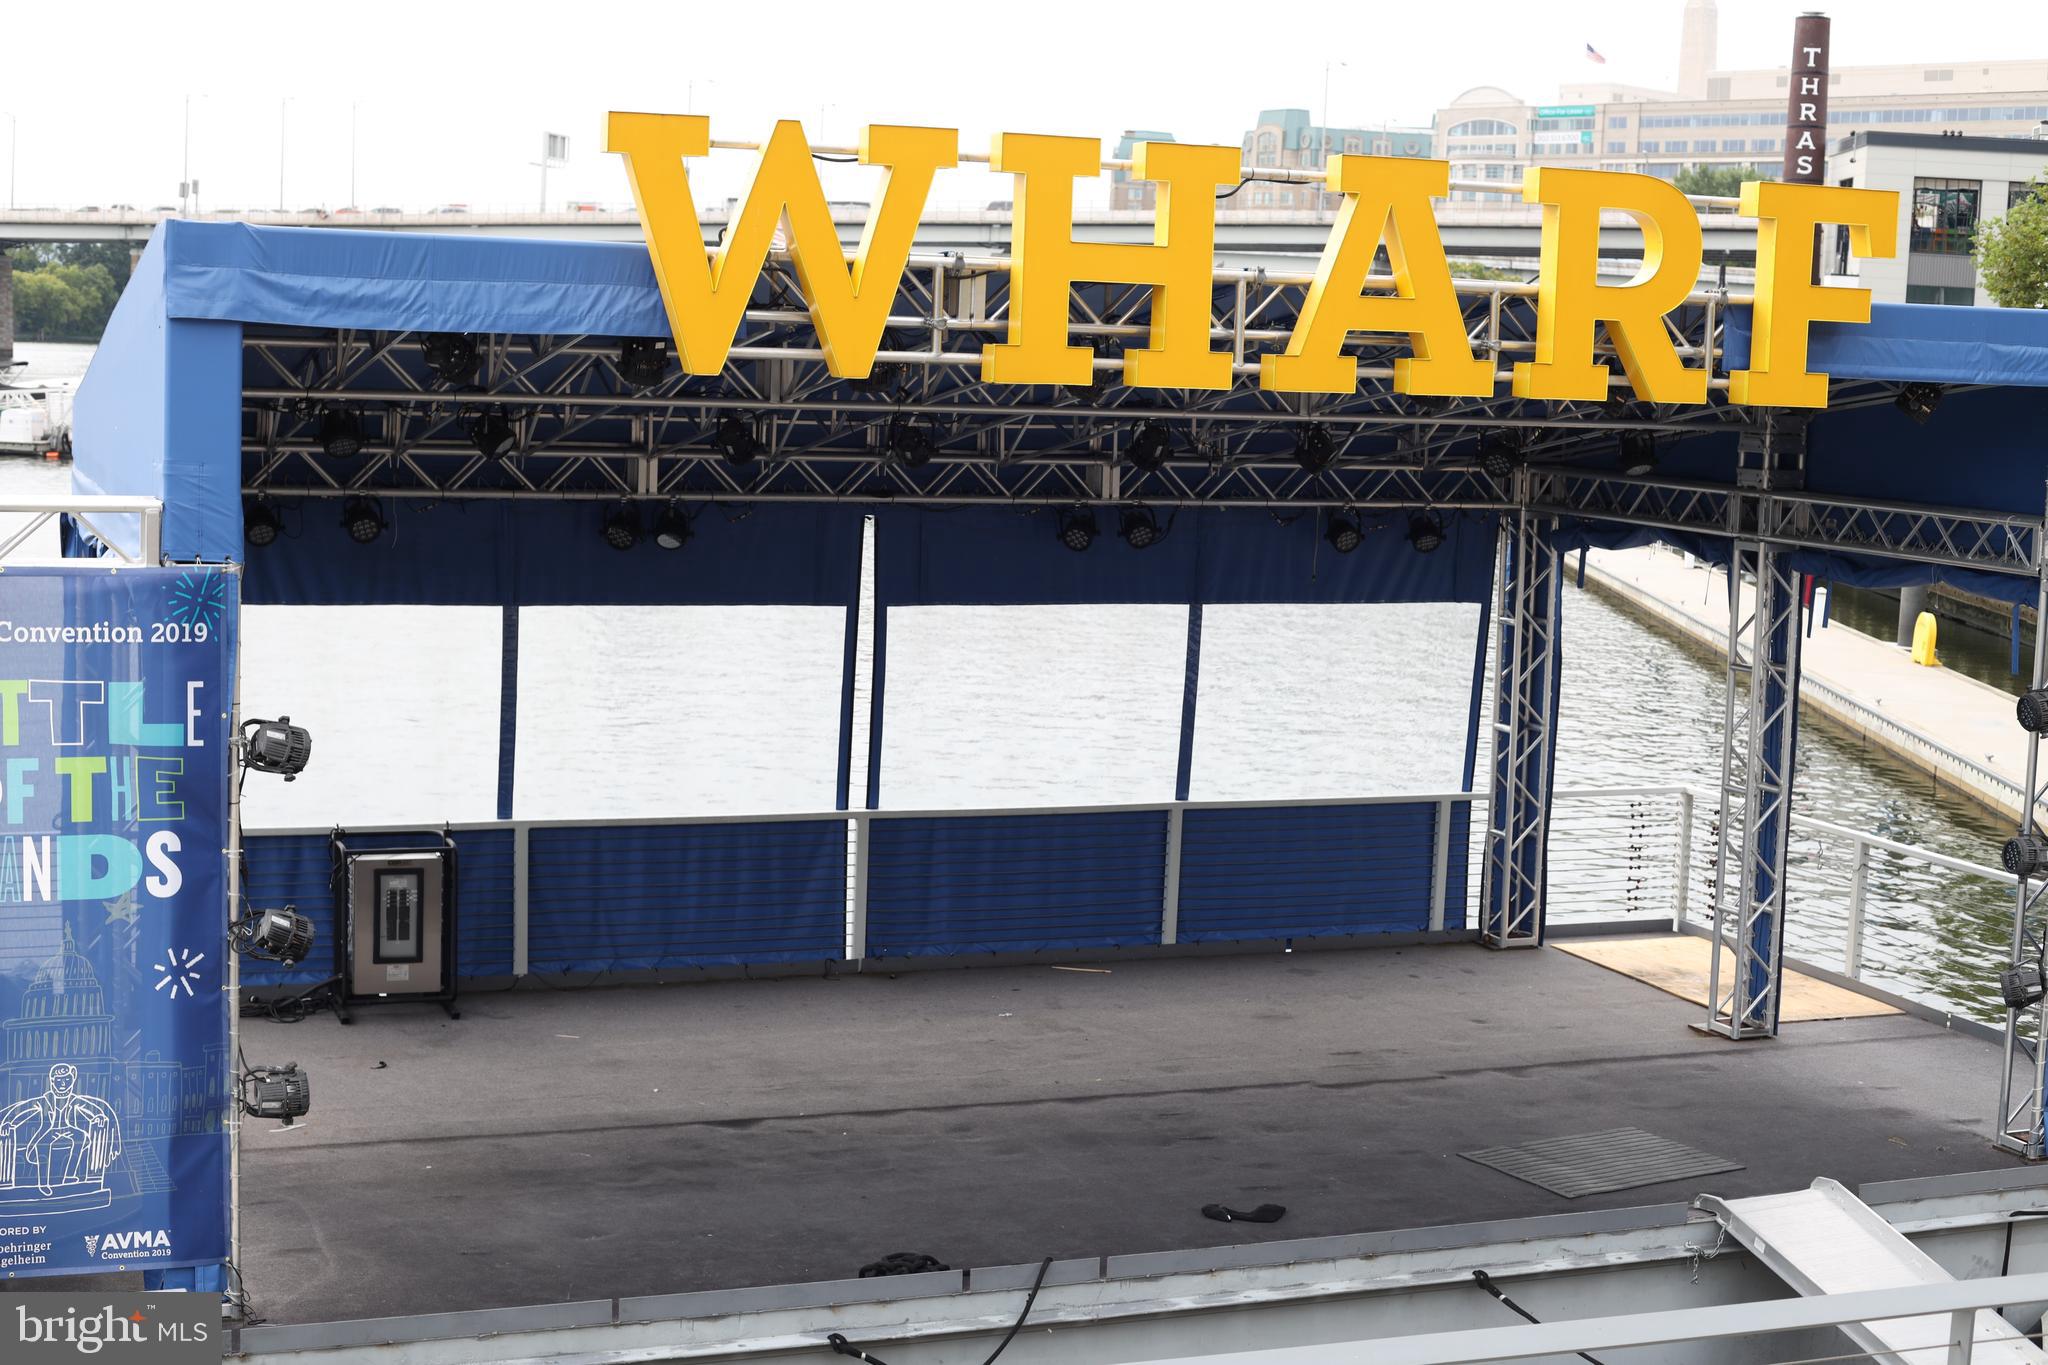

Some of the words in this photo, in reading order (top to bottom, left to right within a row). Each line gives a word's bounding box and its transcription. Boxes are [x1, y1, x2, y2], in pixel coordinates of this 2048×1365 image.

[601, 111, 1900, 409] WHARF
[0, 621, 143, 643] Convention
[151, 622, 208, 643] 2019
[55, 756, 185, 822] THE
[32, 1225, 47, 1235] BY
[101, 1230, 171, 1251] AVMA
[101, 1250, 150, 1260] Convention
[151, 1248, 172, 1257] 2019
